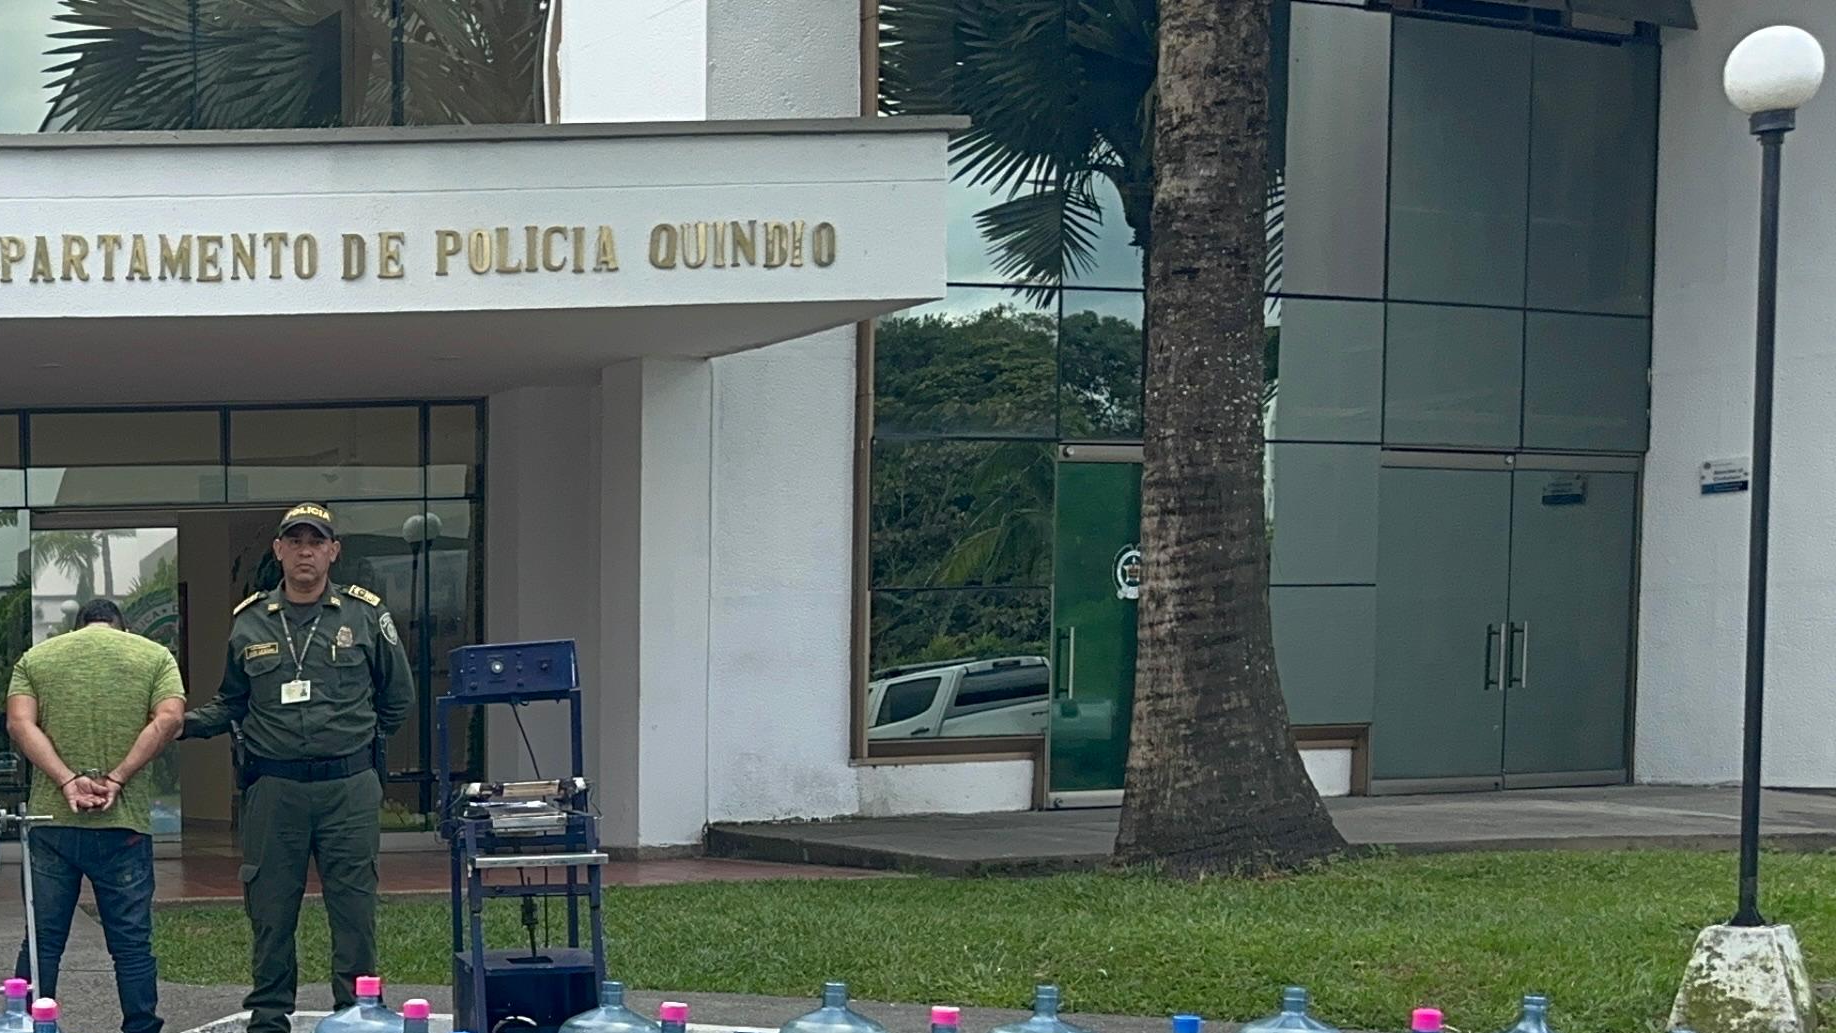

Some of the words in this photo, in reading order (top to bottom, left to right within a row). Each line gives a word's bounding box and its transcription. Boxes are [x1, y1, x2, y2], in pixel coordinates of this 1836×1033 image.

[341, 231, 405, 281] DE
[434, 224, 620, 277] POLICIA
[648, 219, 837, 271] QUINDIO
[285, 506, 331, 522] POLICIA
